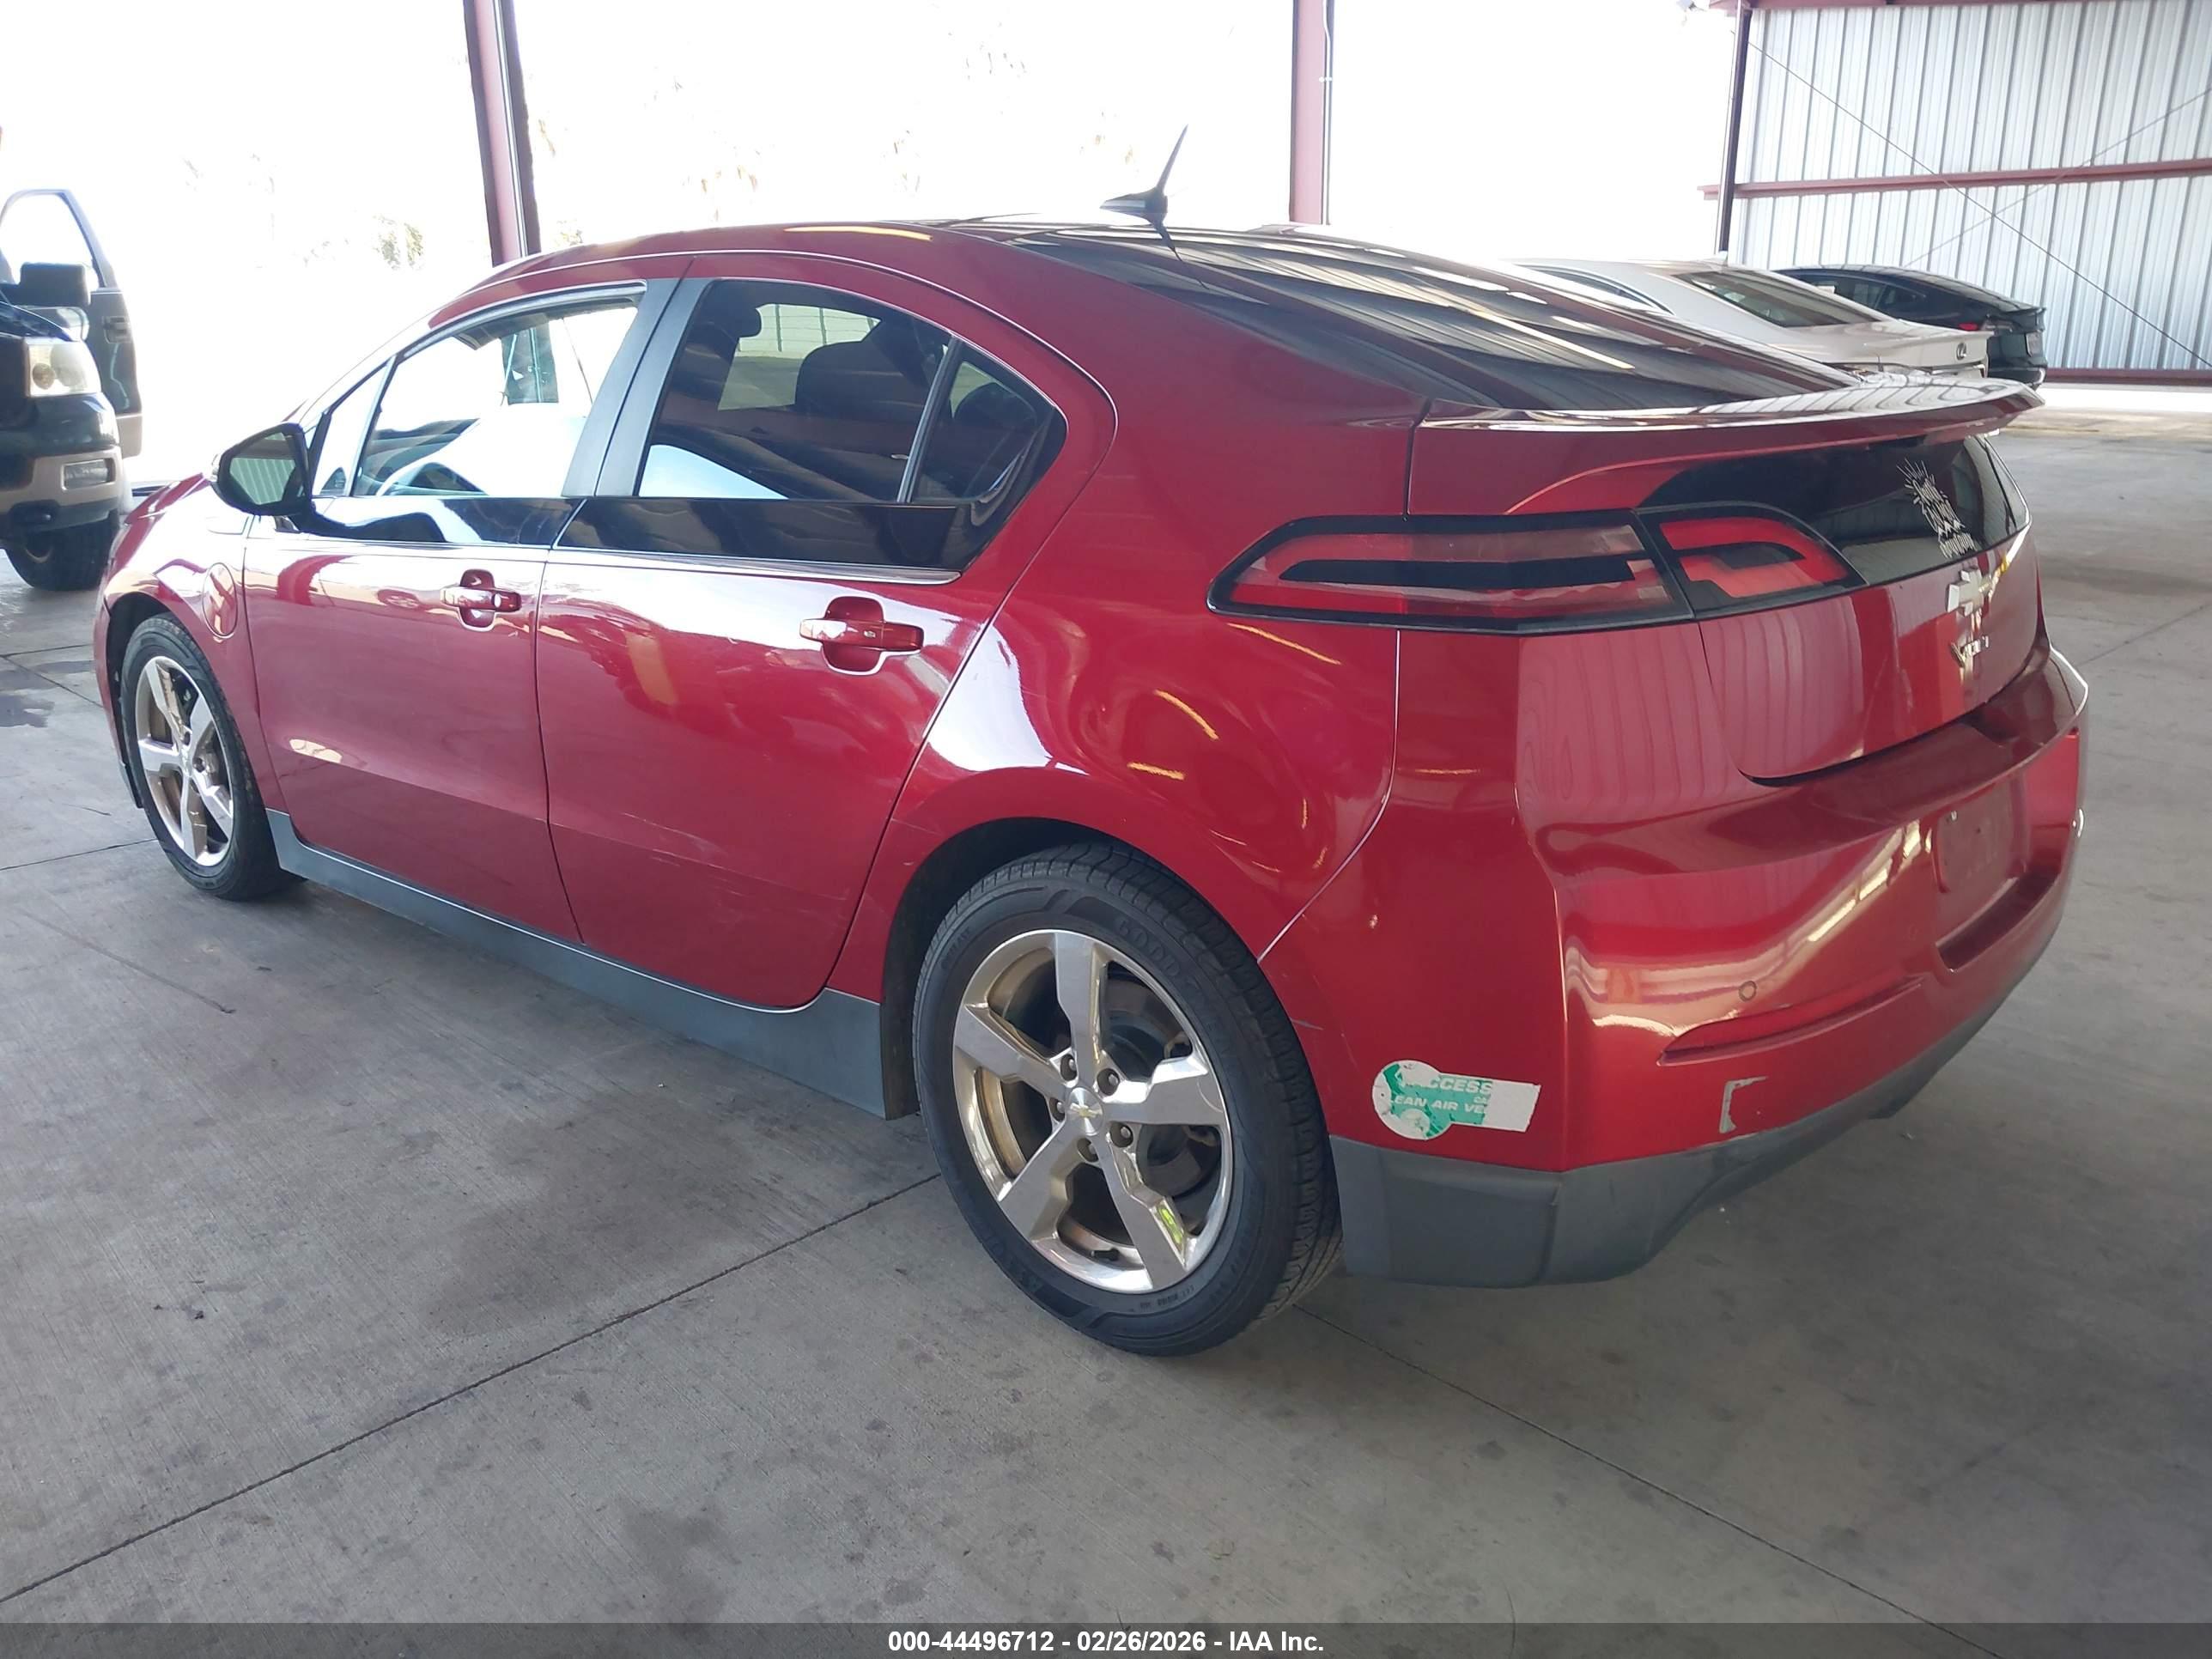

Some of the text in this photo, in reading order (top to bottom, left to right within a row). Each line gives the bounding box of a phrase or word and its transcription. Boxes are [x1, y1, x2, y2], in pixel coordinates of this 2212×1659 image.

[1429, 1076, 1492, 1095] CCESS
[1391, 1095, 1485, 1114] EAN AIR VE
